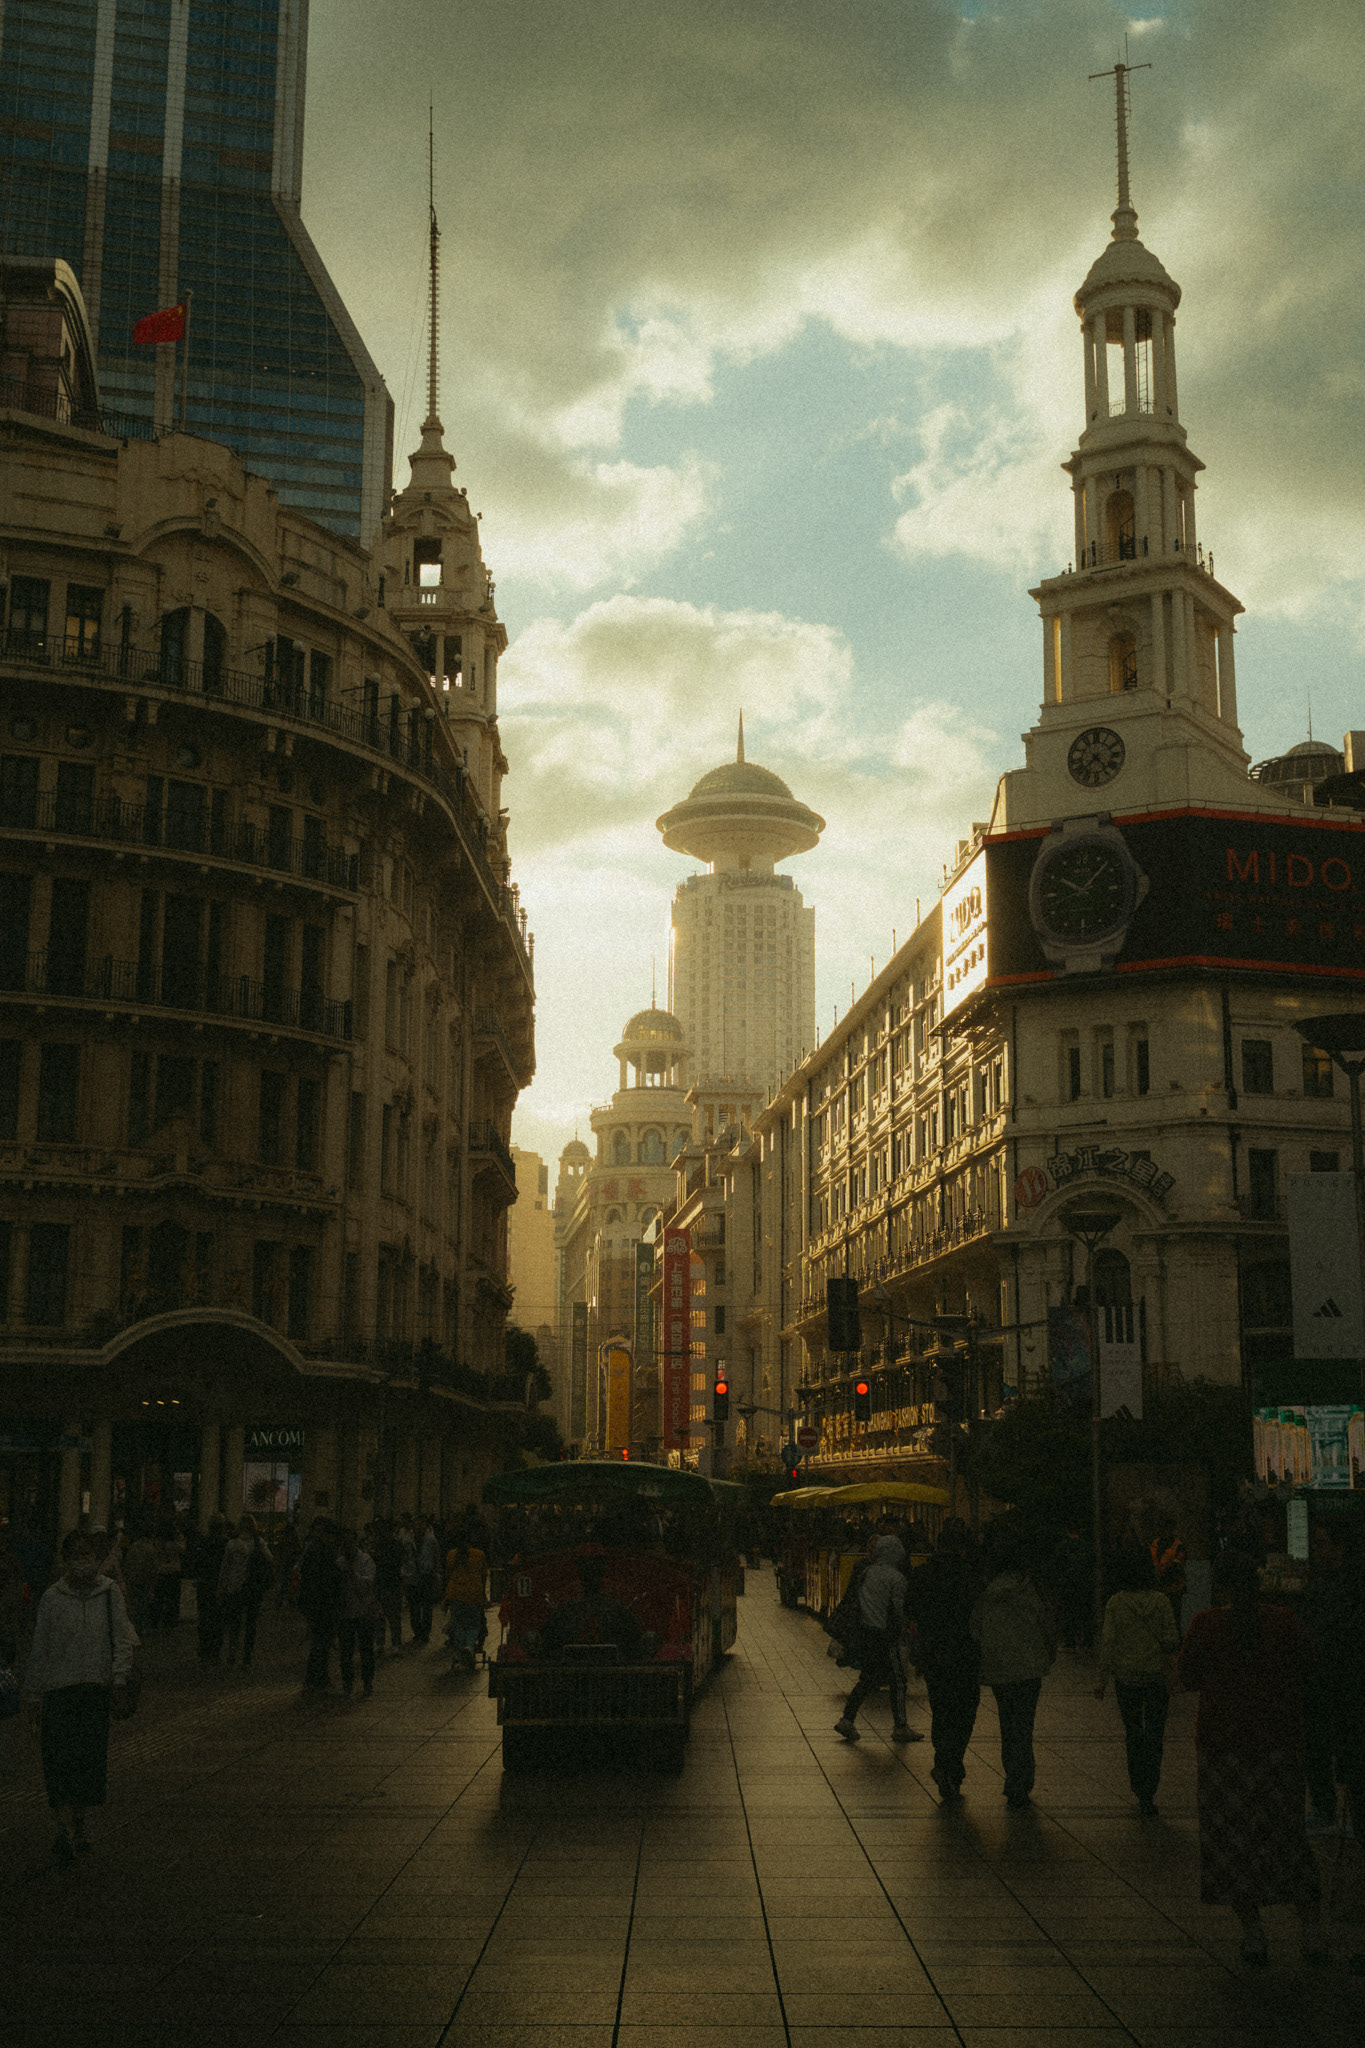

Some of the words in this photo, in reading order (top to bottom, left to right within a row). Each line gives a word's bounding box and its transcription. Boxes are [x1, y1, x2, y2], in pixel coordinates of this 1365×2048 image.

[1226, 848, 1353, 891] MIDO
[1047, 1144, 1158, 1187] 锦江之星
